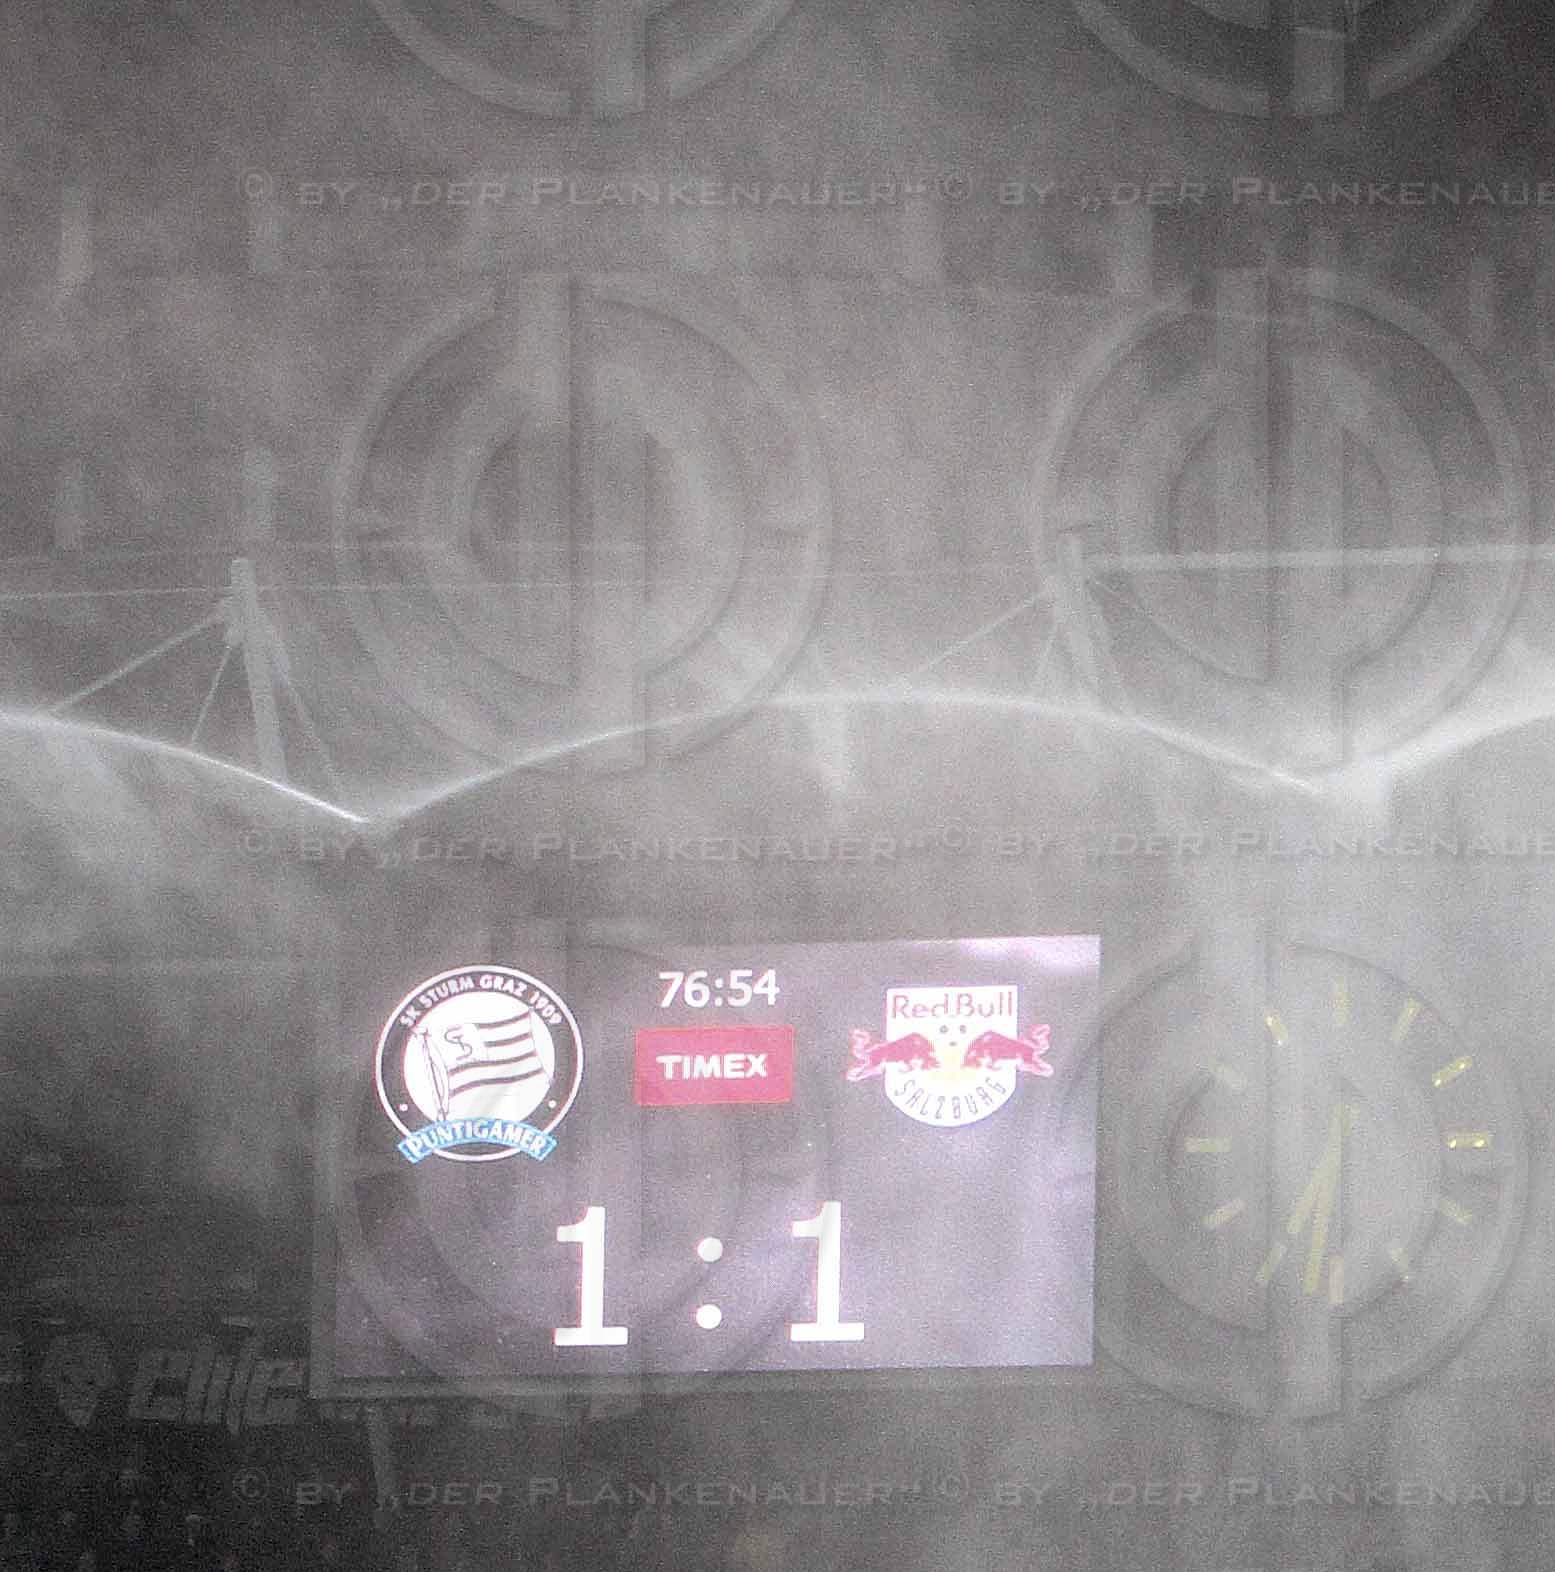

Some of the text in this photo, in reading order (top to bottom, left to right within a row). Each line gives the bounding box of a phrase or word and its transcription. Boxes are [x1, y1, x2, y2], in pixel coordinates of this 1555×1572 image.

[420, 975, 474, 1009] STURM
[480, 974, 528, 996] GRAZ
[659, 968, 780, 1008] 76:54
[892, 991, 1013, 1019] Red Bull
[657, 1054, 768, 1082] TIMEX
[404, 1121, 548, 1157] PUNTIGAMER
[553, 1206, 629, 1346] 1
[789, 1201, 865, 1342] 1
